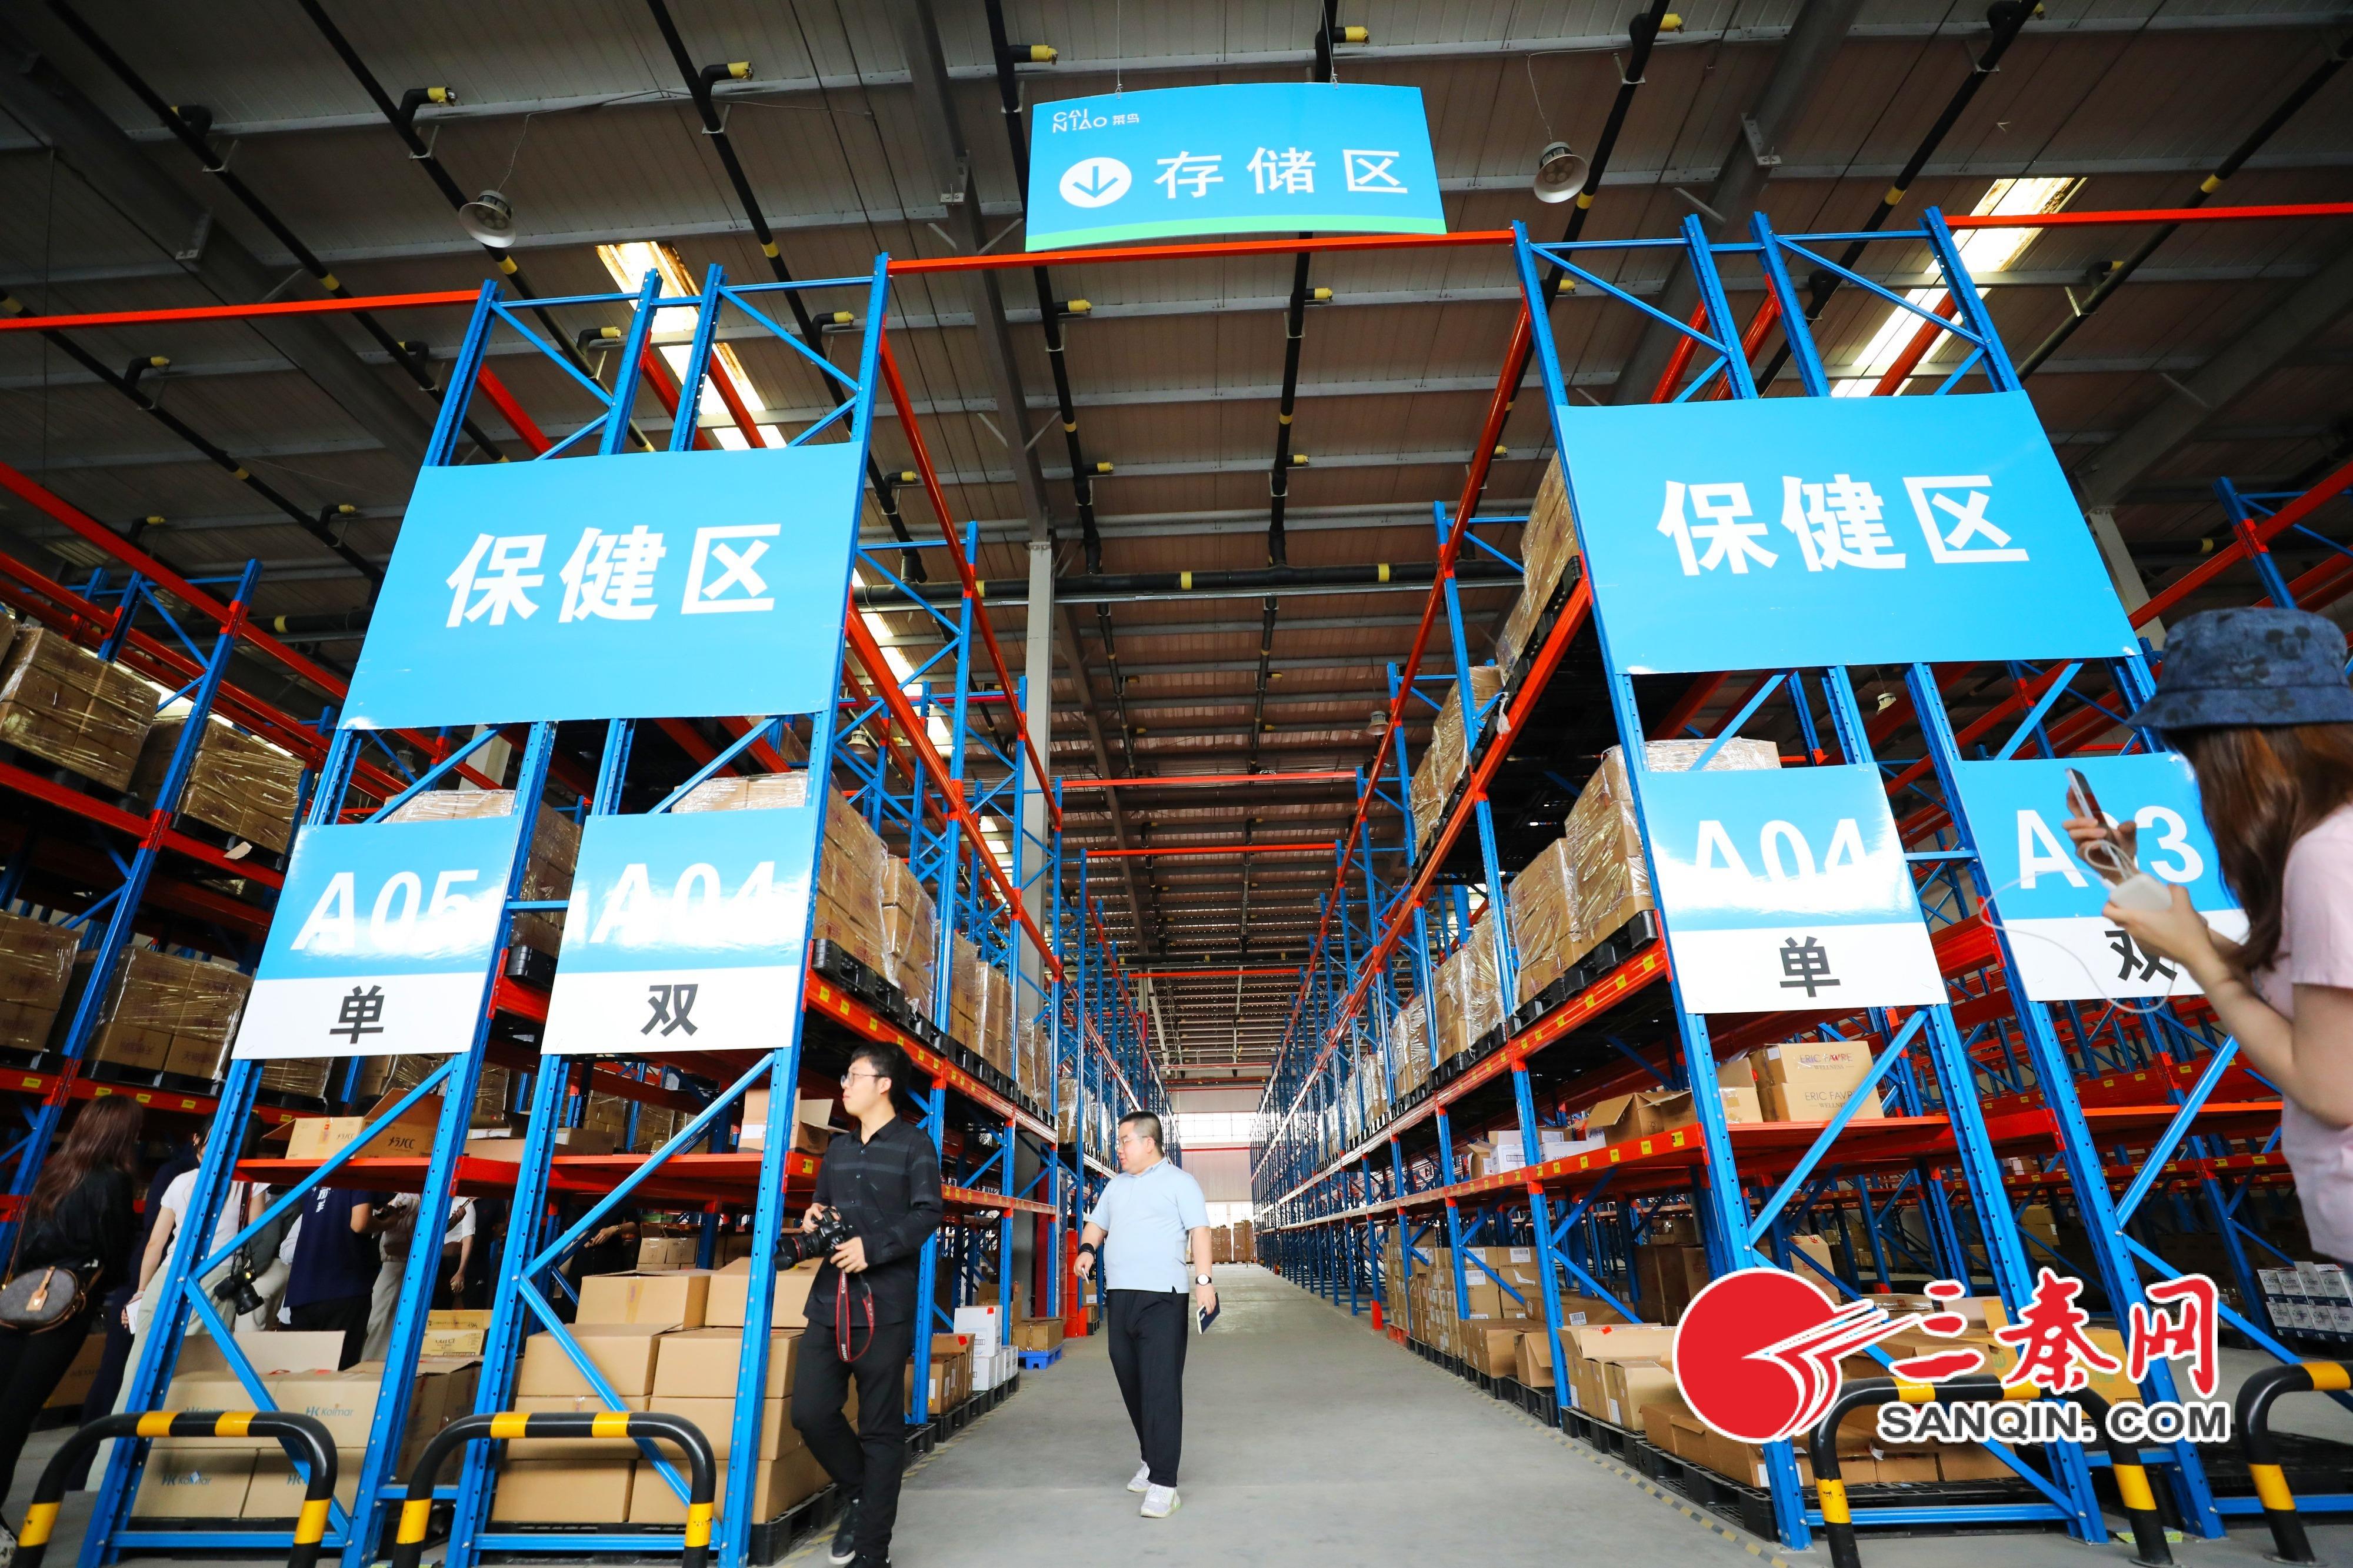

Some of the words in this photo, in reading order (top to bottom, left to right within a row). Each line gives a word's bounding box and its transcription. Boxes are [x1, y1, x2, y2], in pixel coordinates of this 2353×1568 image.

[1112, 113, 1139, 126] 菜鸟
[1154, 146, 1408, 199] 存储区
[1656, 473, 2030, 576] 保健区
[445, 523, 781, 628] 保健区
[1692, 818, 1877, 899] A04
[2017, 805, 2204, 889] A3
[290, 869, 479, 950] A05
[588, 860, 781, 944] A04
[1779, 936, 1841, 998] 单
[329, 985, 385, 1045] 单
[640, 983, 699, 1037] 双
[1799, 1054, 1821, 1063] ERIC
[1805, 1092, 1827, 1101] ERIC
[1829, 1091, 1854, 1100] FAVR
[321, 1406, 354, 1417] Kolmar
